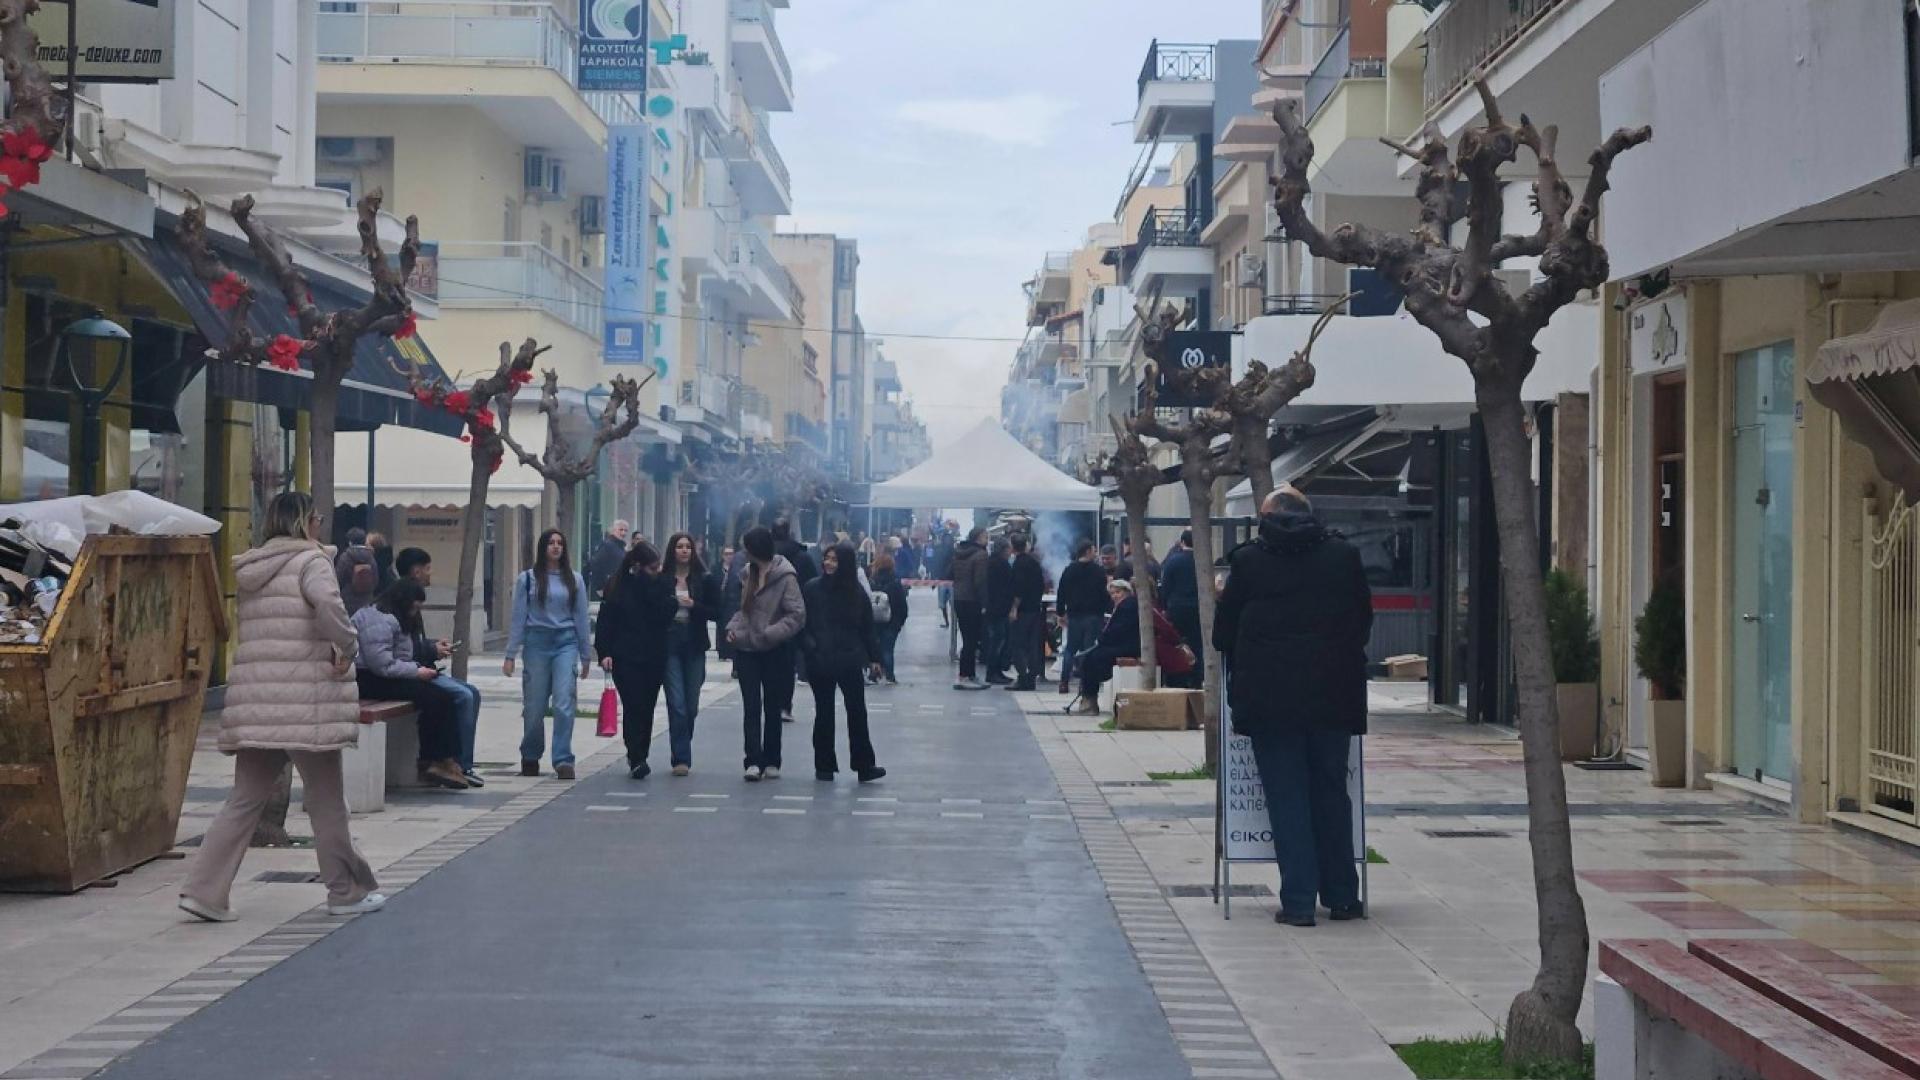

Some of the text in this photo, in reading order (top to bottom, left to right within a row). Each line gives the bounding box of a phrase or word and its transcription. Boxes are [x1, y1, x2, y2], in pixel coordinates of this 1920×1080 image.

[38, 45, 162, 63] metl-deluxe.com
[582, 44, 644, 54] ΑΚΟΥΣΤΙΚΑ
[584, 68, 641, 80] SIEMENS
[1229, 738, 1251, 751] ΚΕΡ
[1230, 783, 1264, 796] ΚΑΝΤ
[1230, 798, 1267, 811] ΚΑΠΕ
[1230, 830, 1273, 842] ΕΙΚΟ
